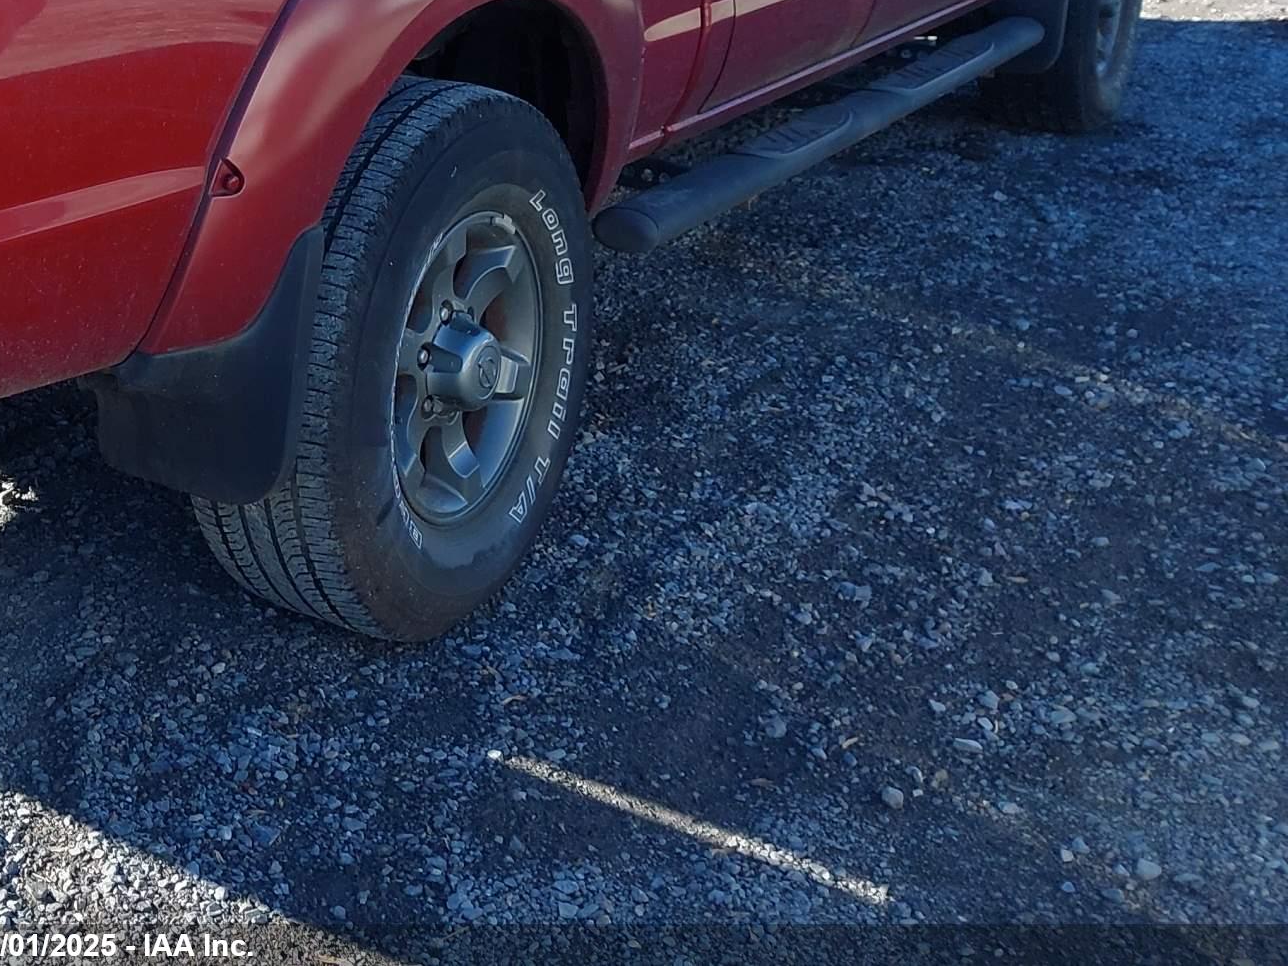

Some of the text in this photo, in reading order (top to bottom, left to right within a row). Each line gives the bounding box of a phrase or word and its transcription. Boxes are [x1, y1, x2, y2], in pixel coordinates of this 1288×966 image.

[508, 189, 578, 524] Long Trail T/A
